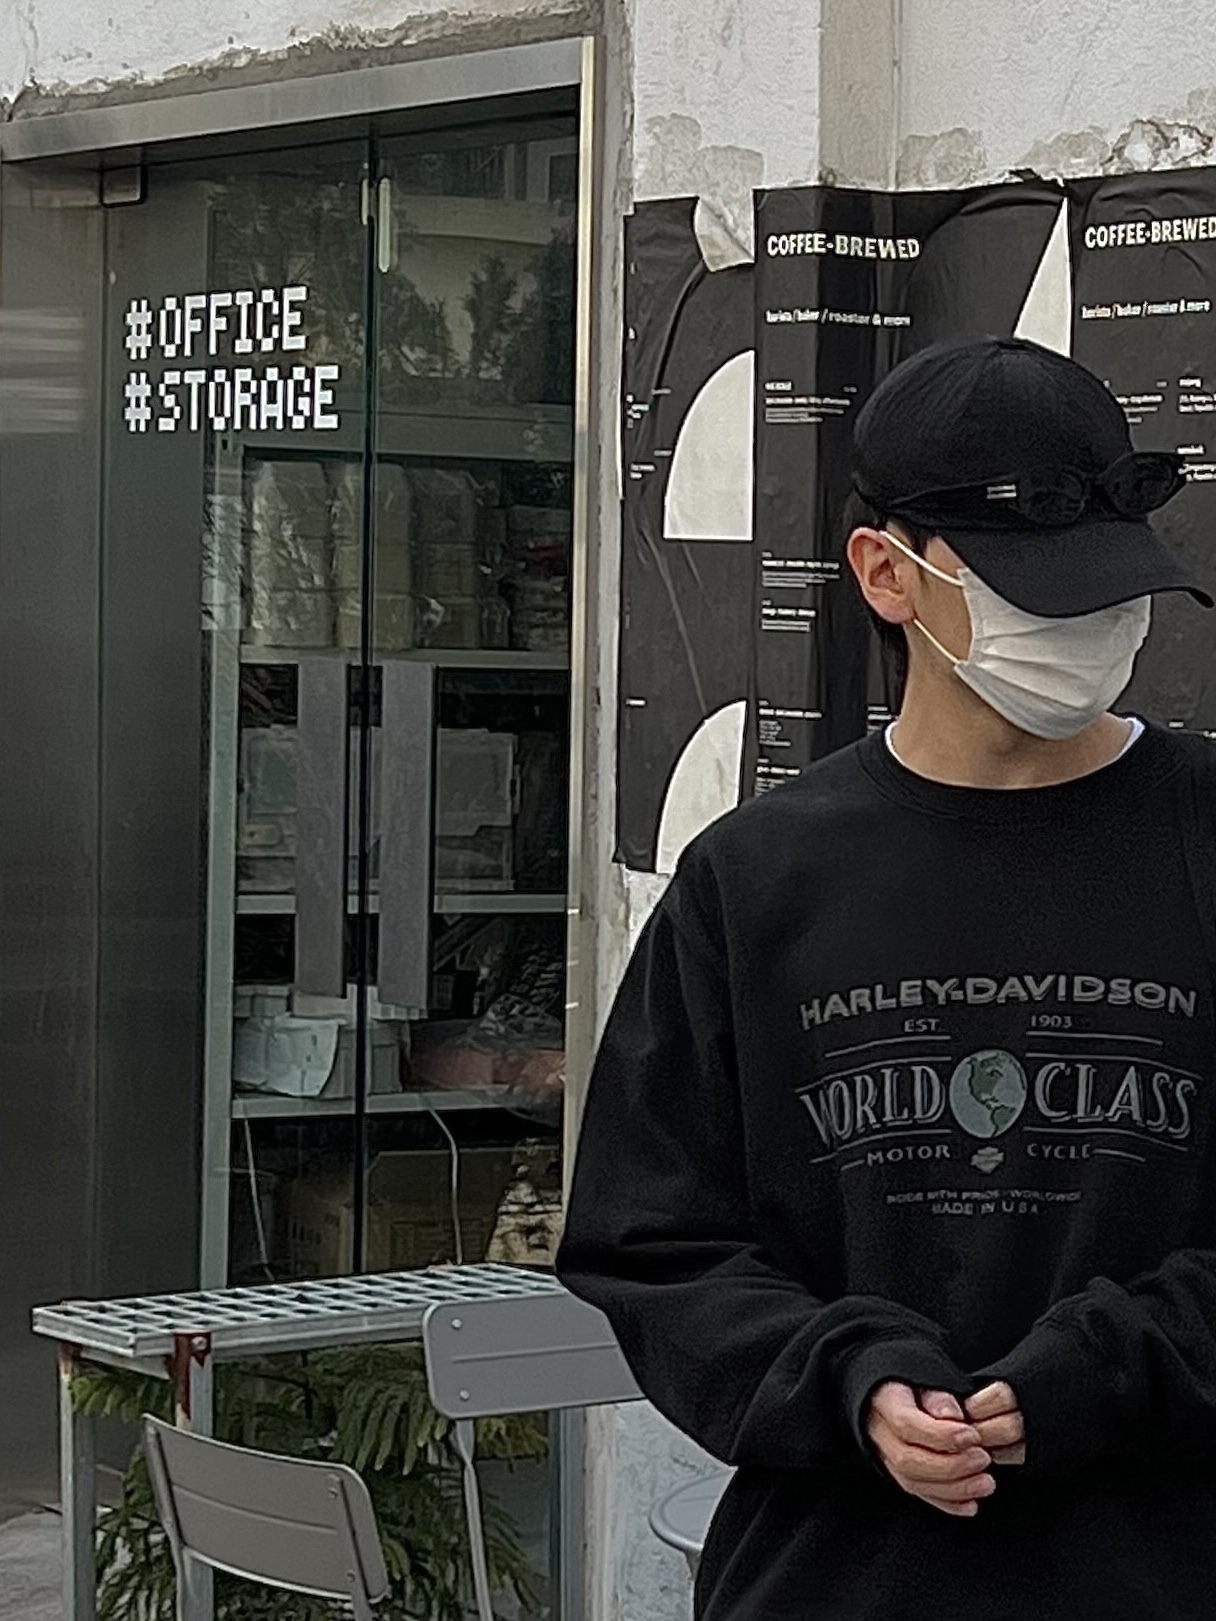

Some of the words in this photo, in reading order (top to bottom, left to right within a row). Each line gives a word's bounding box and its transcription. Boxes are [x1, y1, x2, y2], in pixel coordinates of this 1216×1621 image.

[125, 286, 308, 360] #OFFICE
[124, 365, 339, 433] #STORAGE
[799, 974, 1198, 1031] HARLEY-DAVIDSON
[1031, 1014, 1073, 1029] 1903
[799, 1062, 948, 1150] WORLD
[1033, 1061, 1199, 1141] CLASS
[865, 1144, 952, 1167] MOTOR
[1027, 1143, 1091, 1160] CYCLE
